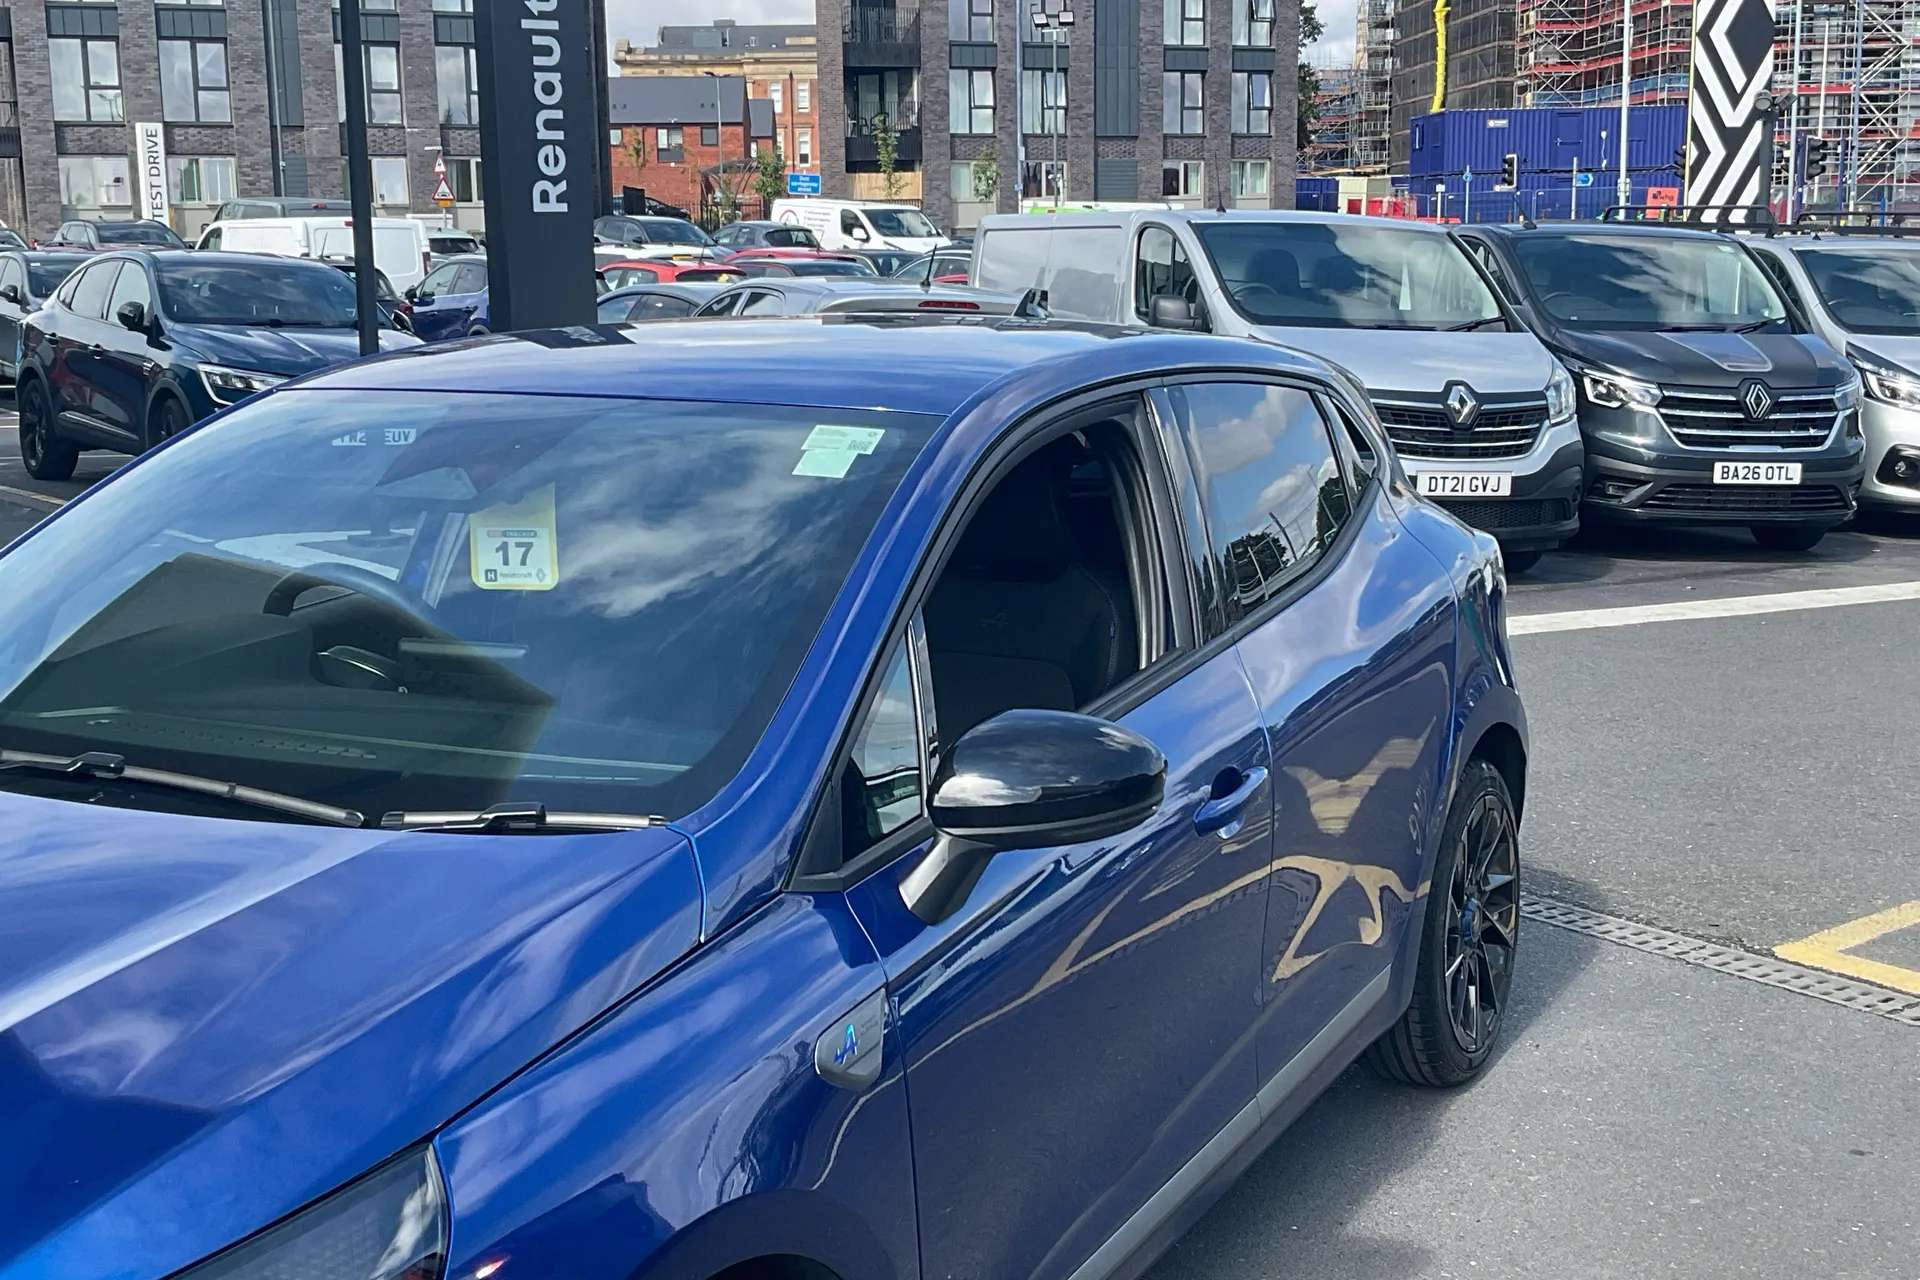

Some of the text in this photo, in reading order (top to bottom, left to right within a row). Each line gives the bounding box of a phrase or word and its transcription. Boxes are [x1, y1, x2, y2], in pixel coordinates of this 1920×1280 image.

[520, 0, 568, 213] Renault
[146, 128, 164, 220] TEST DRIVE
[1427, 476, 1501, 493] DT21 GVJ
[1720, 465, 1794, 481] BA26 OTL
[495, 541, 534, 567] 17
